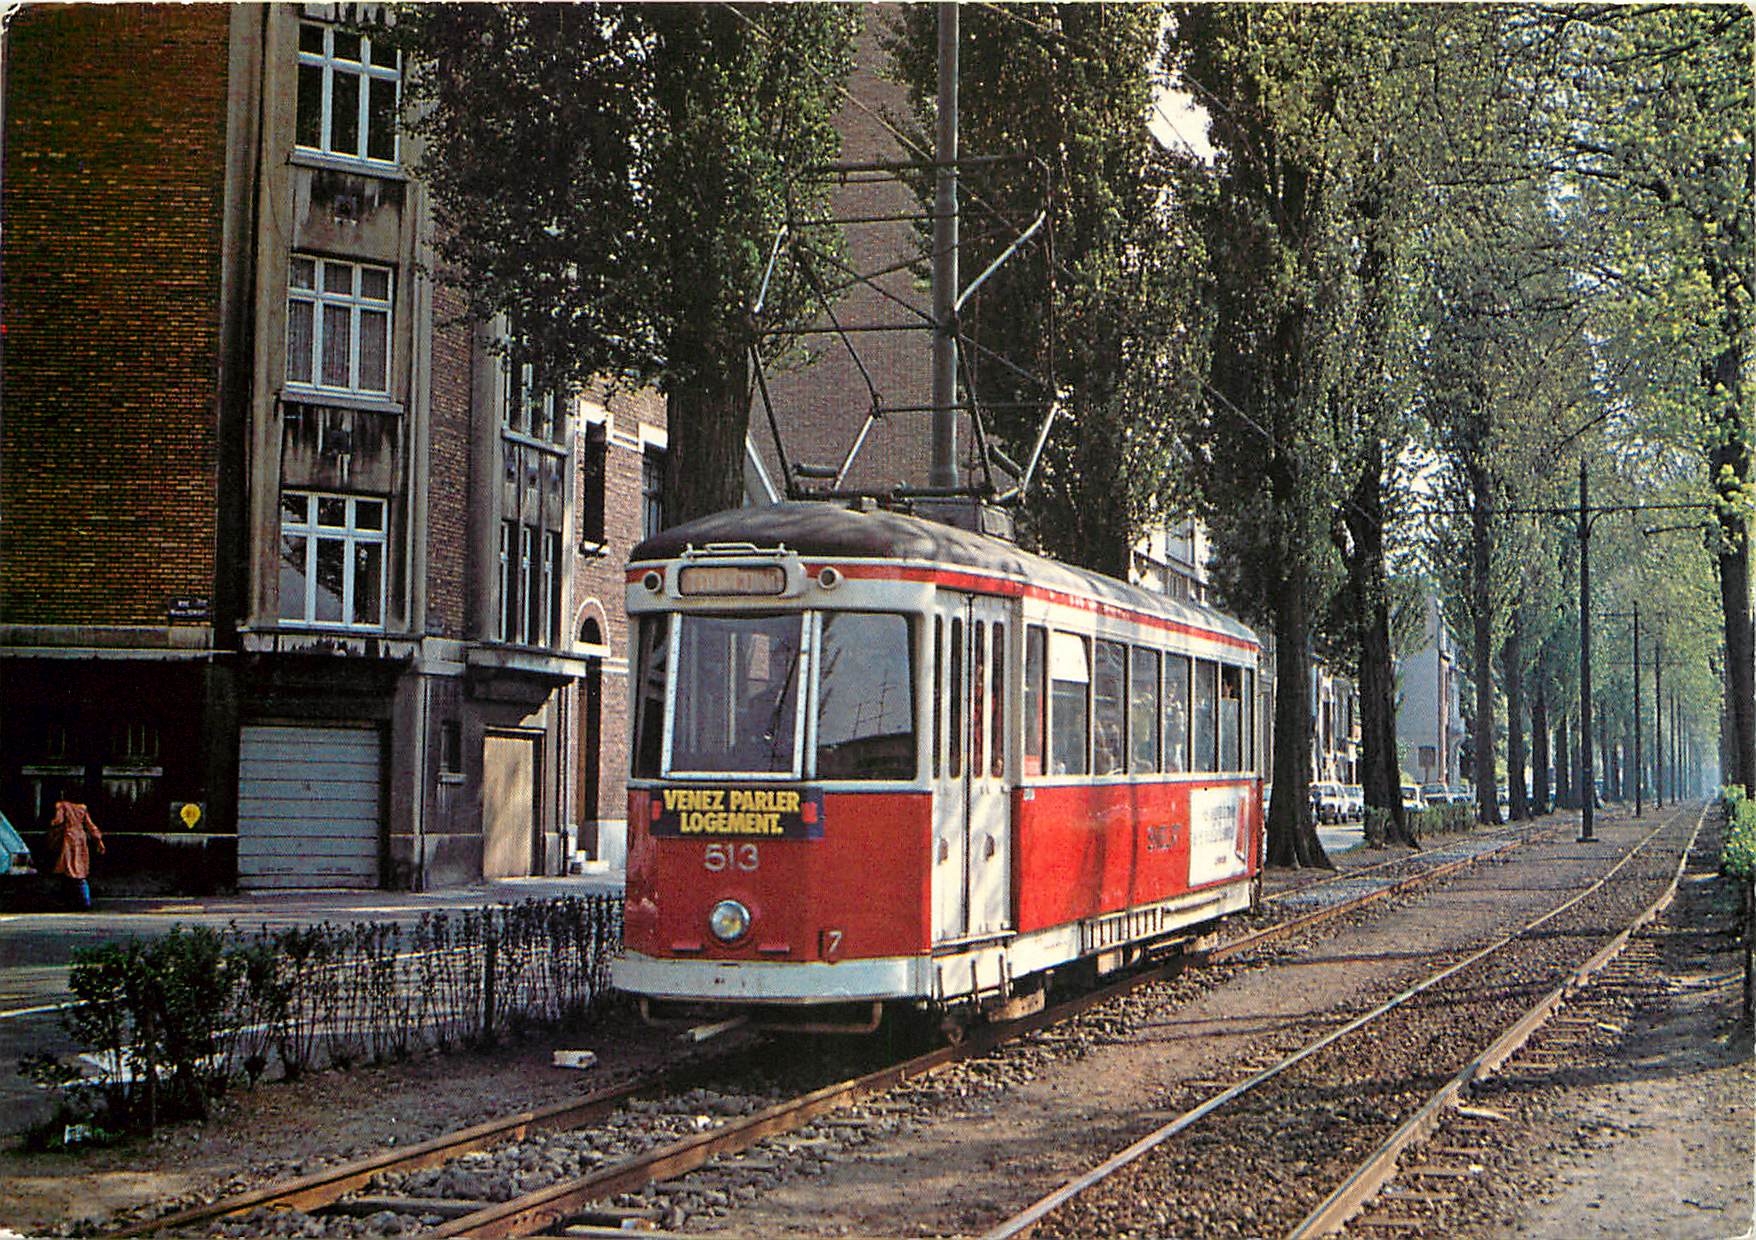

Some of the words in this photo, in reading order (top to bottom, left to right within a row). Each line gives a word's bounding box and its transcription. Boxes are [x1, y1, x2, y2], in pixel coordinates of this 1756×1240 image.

[663, 789, 725, 811] VENEZ
[730, 790, 799, 812] PARLER
[680, 812, 784, 834] LOGEMENT.
[704, 843, 759, 872] 513
[829, 930, 842, 953] 7
